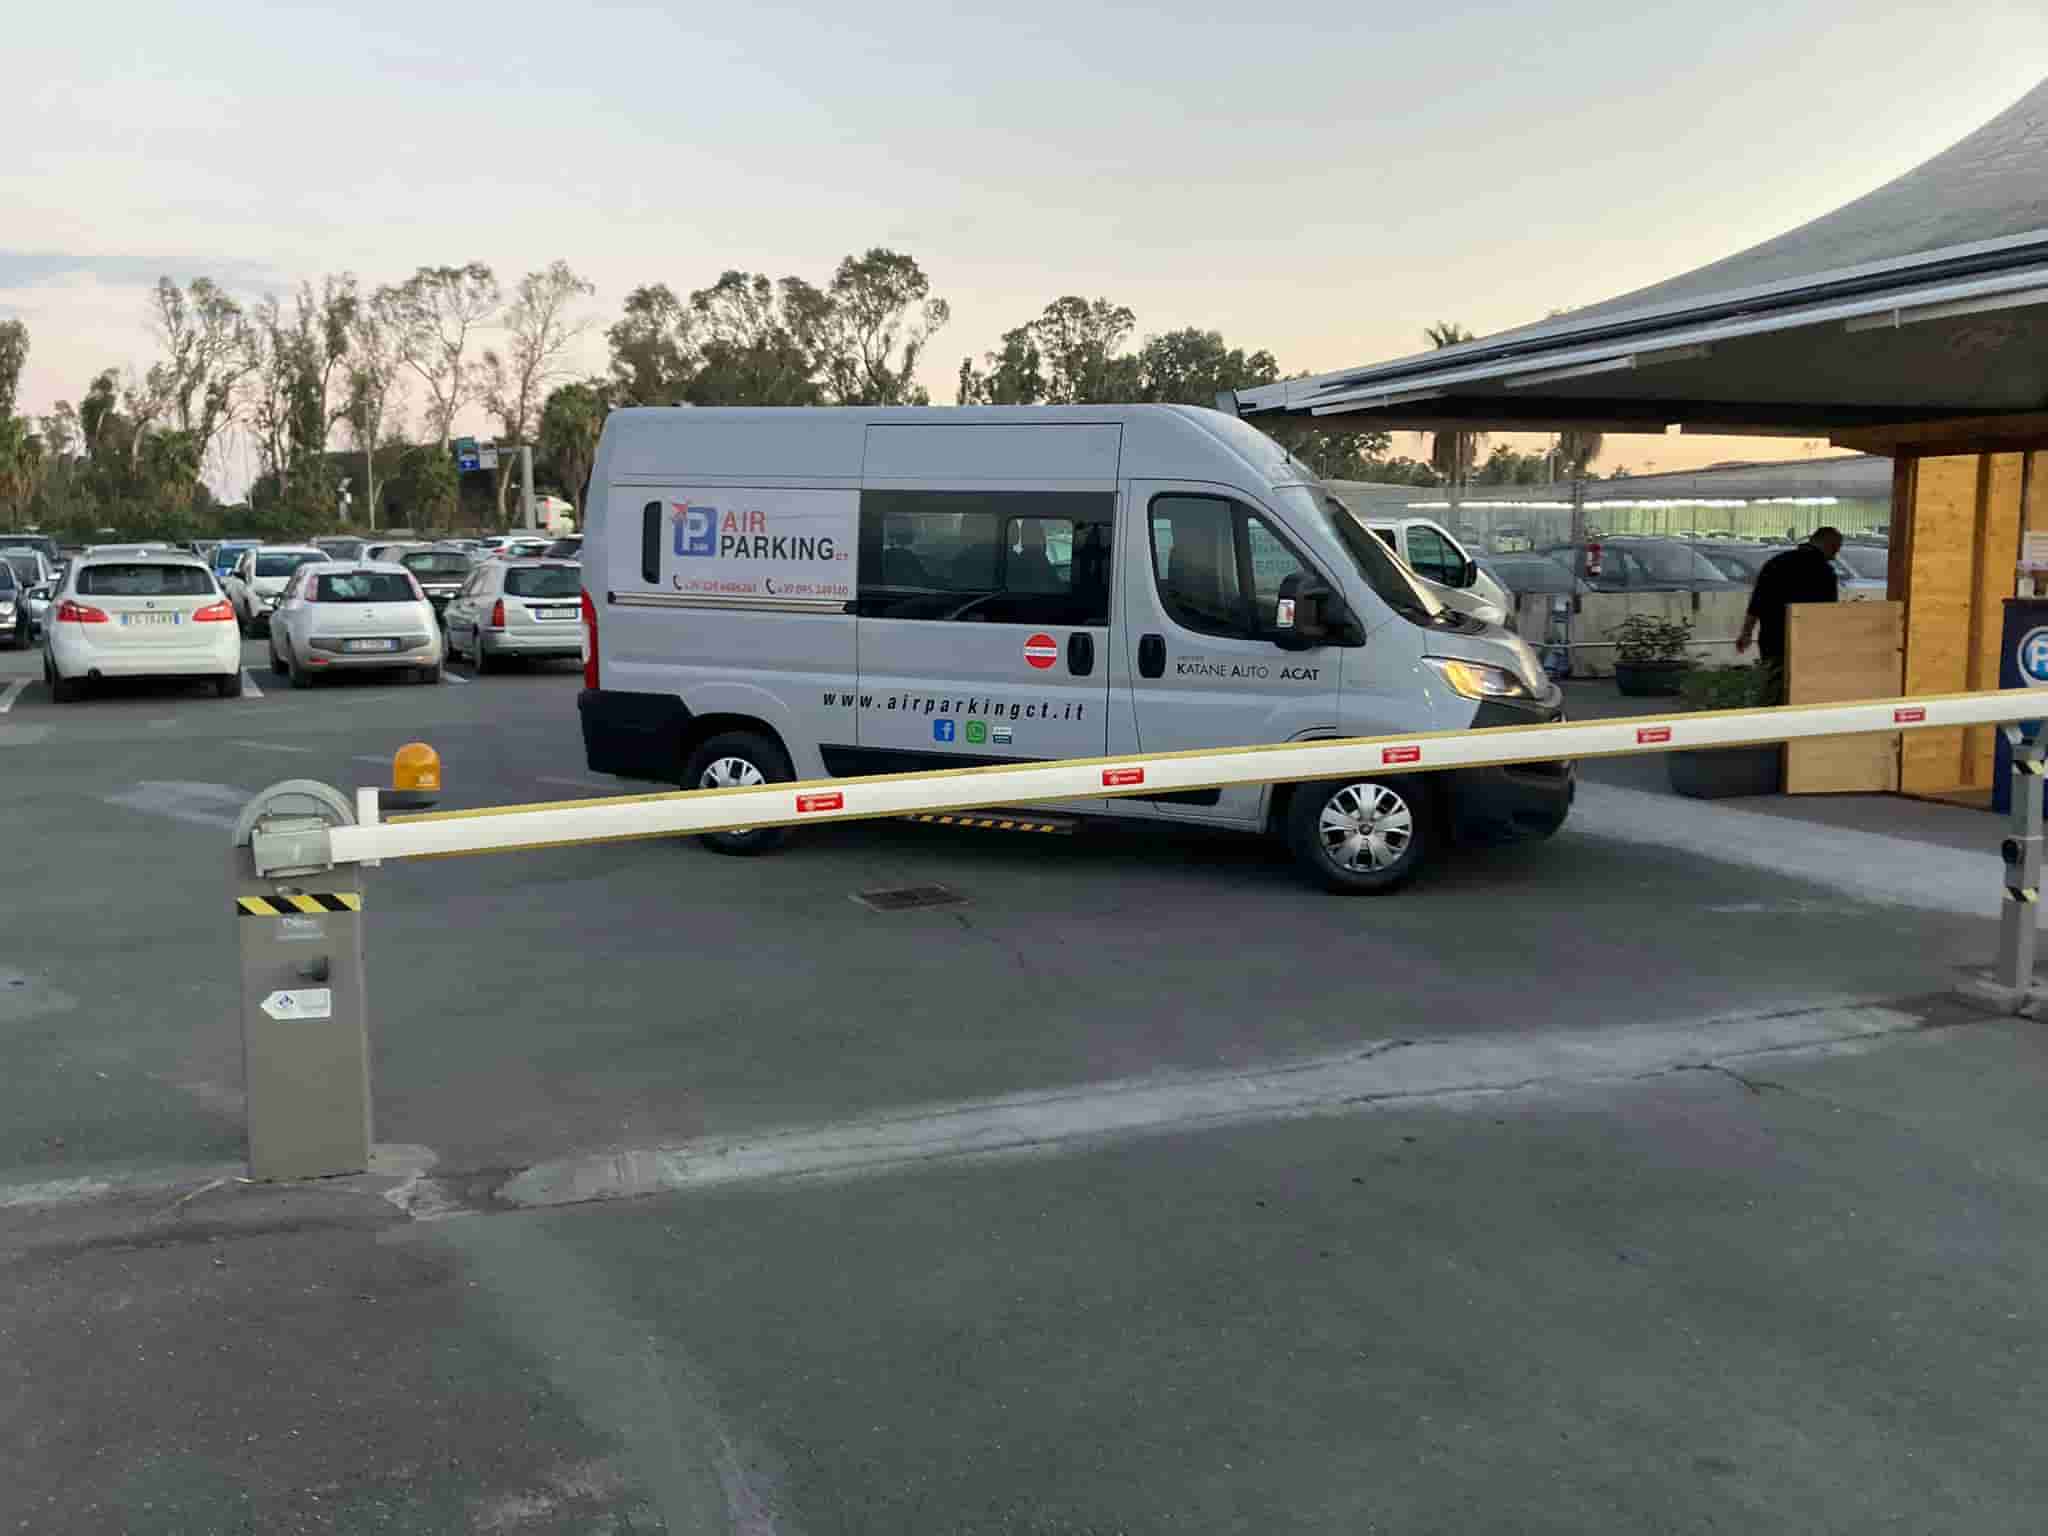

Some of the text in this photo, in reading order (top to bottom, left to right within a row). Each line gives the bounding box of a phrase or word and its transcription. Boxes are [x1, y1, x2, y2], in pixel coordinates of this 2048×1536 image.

[721, 510, 766, 533] AIR
[720, 535, 835, 561] PARKING
[1176, 663, 1321, 681] KATANE AUTO ACAT
[823, 692, 1085, 721] www.airparkingct.it
